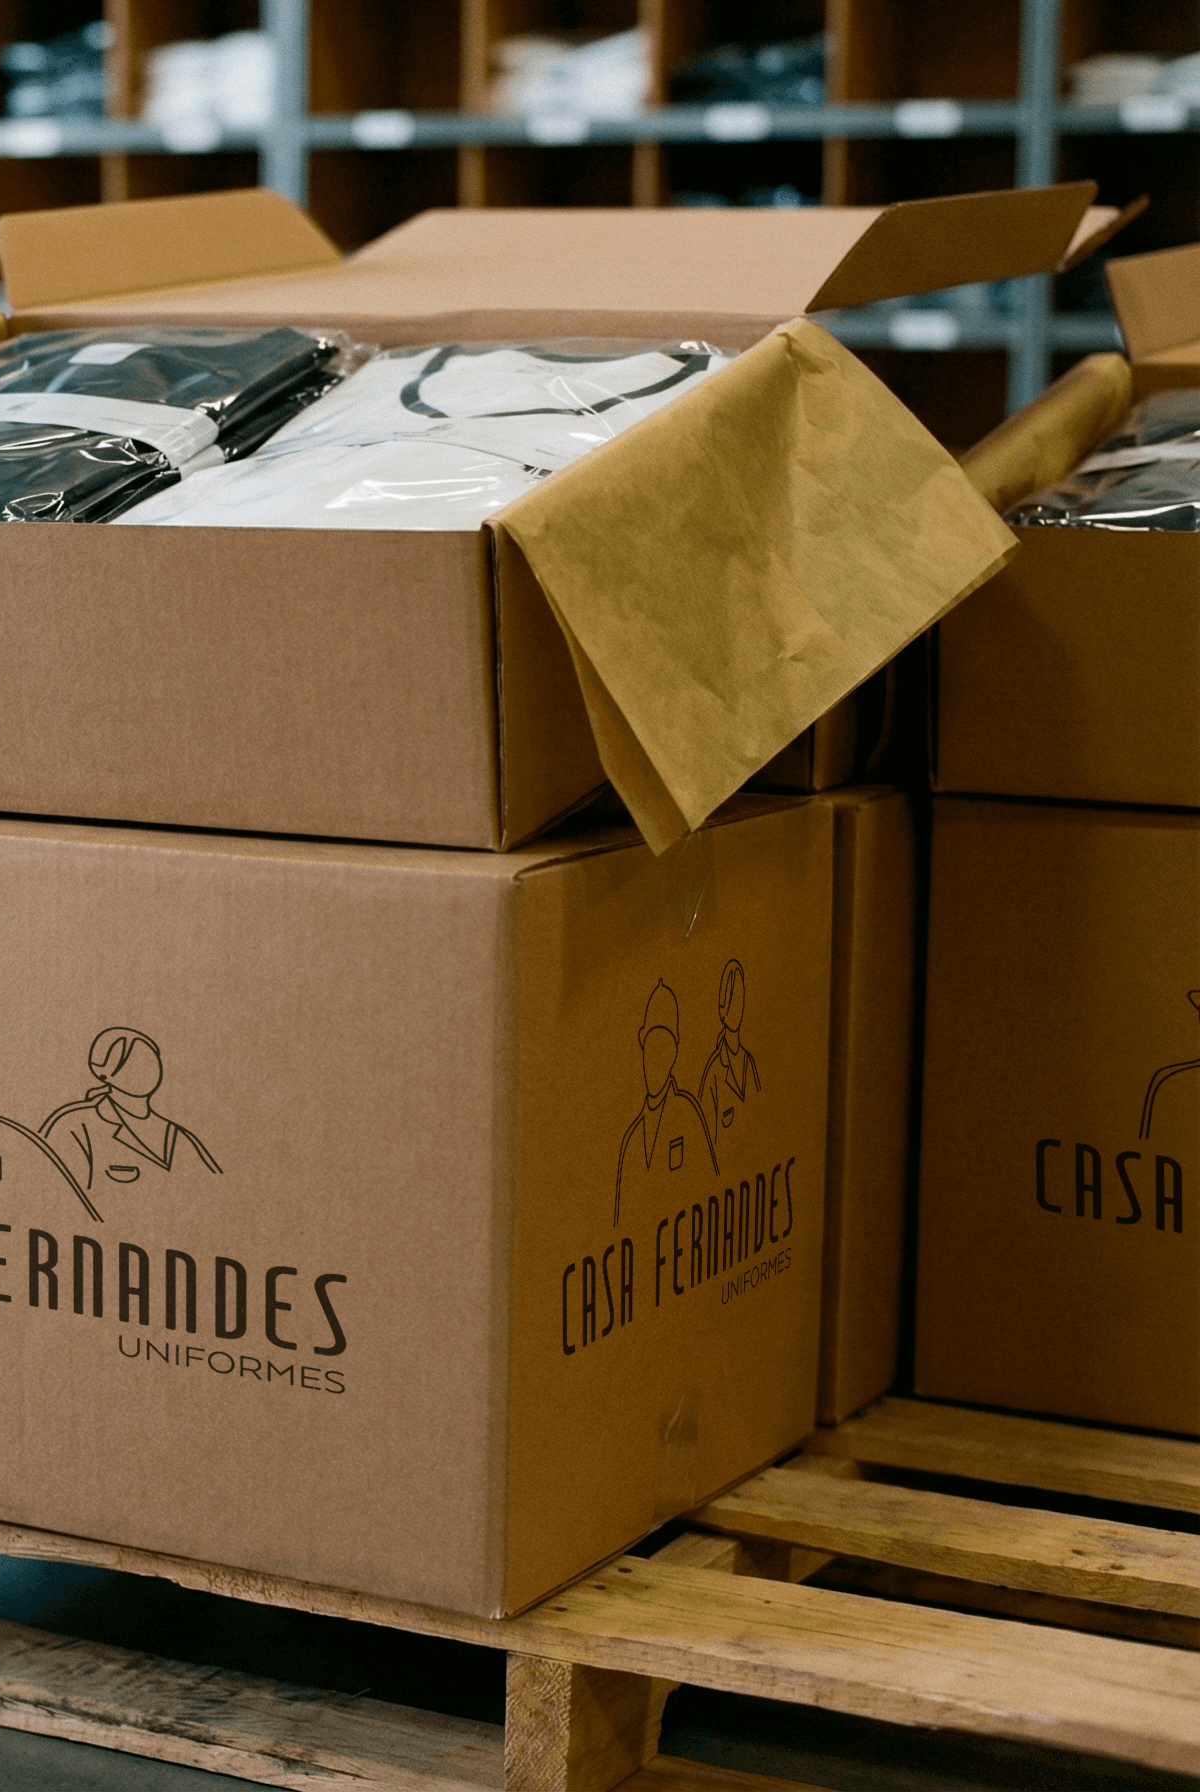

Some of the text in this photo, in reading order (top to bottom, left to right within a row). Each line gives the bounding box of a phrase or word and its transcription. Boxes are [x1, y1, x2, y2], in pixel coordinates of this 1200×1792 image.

[1035, 1138, 1183, 1234] CASA
[562, 1156, 796, 1356] CASA FERNANDES
[720, 1247, 792, 1305] UNIFORMES
[118, 1333, 347, 1395] UNIFORMES
